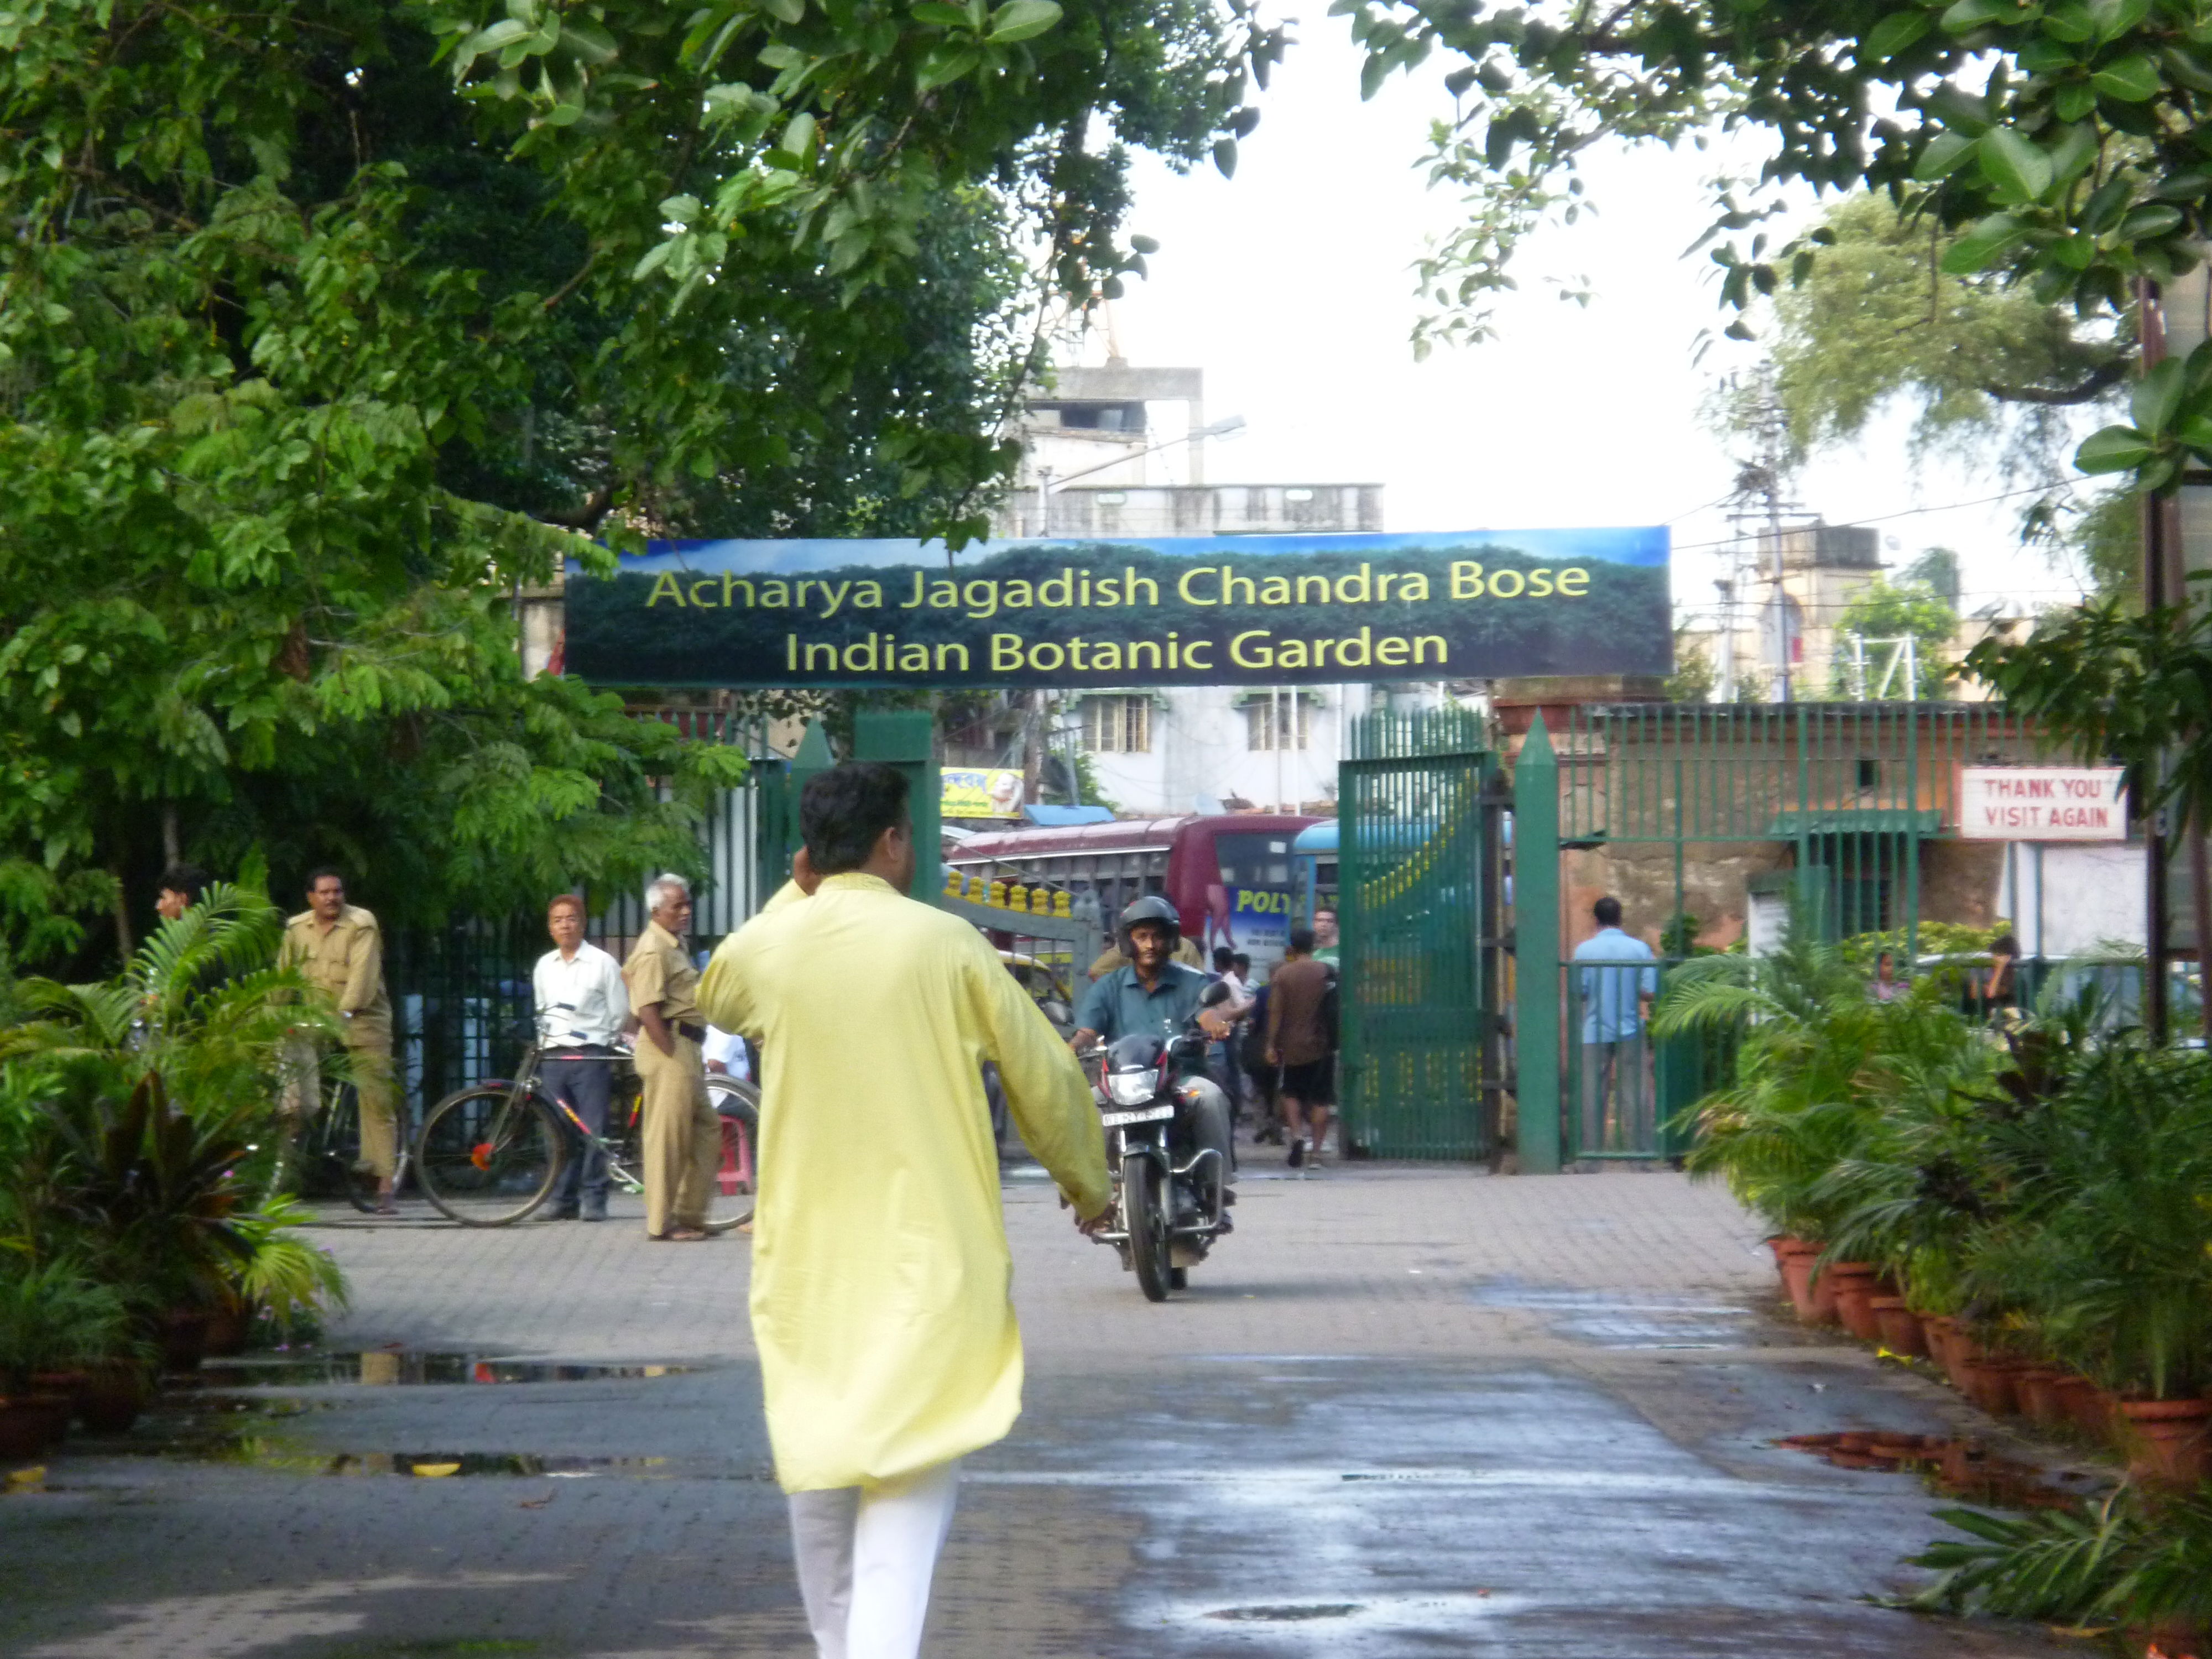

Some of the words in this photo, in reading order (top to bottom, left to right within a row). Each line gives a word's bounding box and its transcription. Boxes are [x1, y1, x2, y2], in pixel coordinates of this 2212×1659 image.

[647, 569, 883, 618] Acharya
[901, 567, 1159, 619] Jagadish
[1178, 563, 1430, 607] Chandra
[1451, 561, 1590, 600] Bose
[787, 632, 970, 671] Indian
[990, 632, 1213, 671] Botanic
[1229, 626, 1448, 669] Garden
[1984, 779, 2054, 798] THANK
[2062, 779, 2101, 799] YOU
[1985, 806, 2042, 827] VISIT
[2049, 807, 2109, 828] AGAIN
